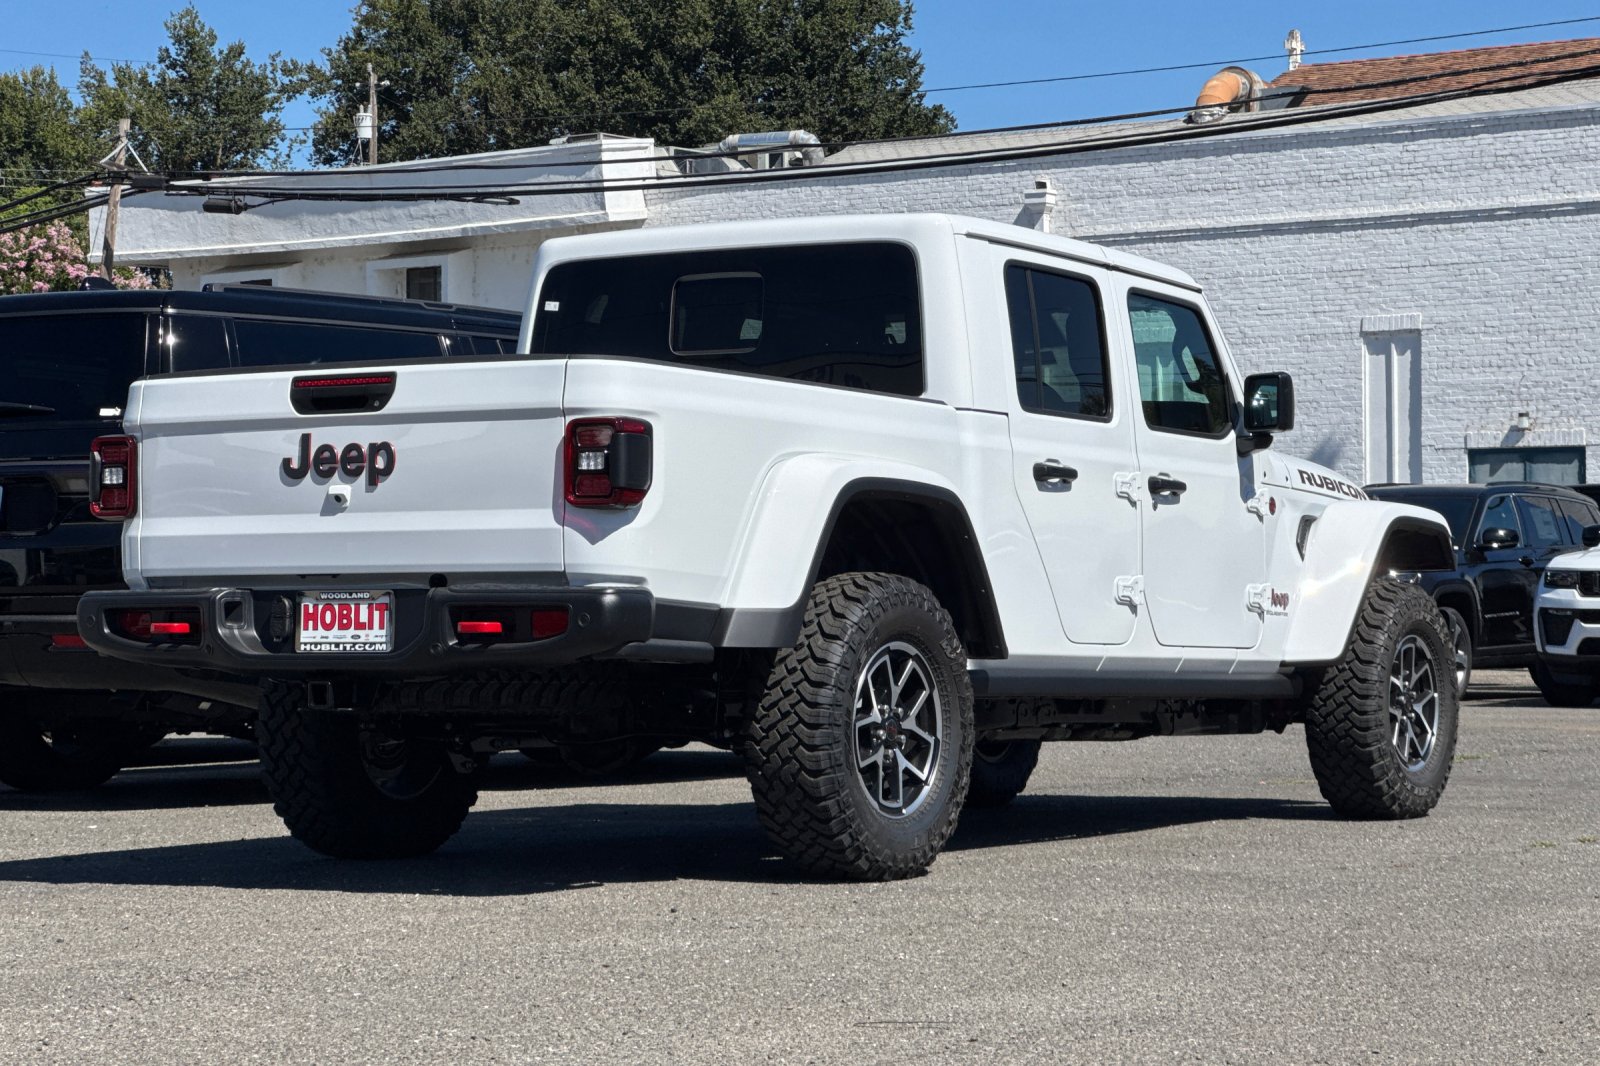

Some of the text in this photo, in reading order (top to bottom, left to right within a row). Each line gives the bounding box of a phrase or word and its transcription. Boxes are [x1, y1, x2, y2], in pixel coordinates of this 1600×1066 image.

[282, 432, 396, 487] Jeep
[1297, 469, 1368, 501] RUBICON
[320, 592, 370, 600] WOODLAND
[303, 603, 389, 631] HOBLIT
[300, 643, 387, 651] HOBLIT.COM
